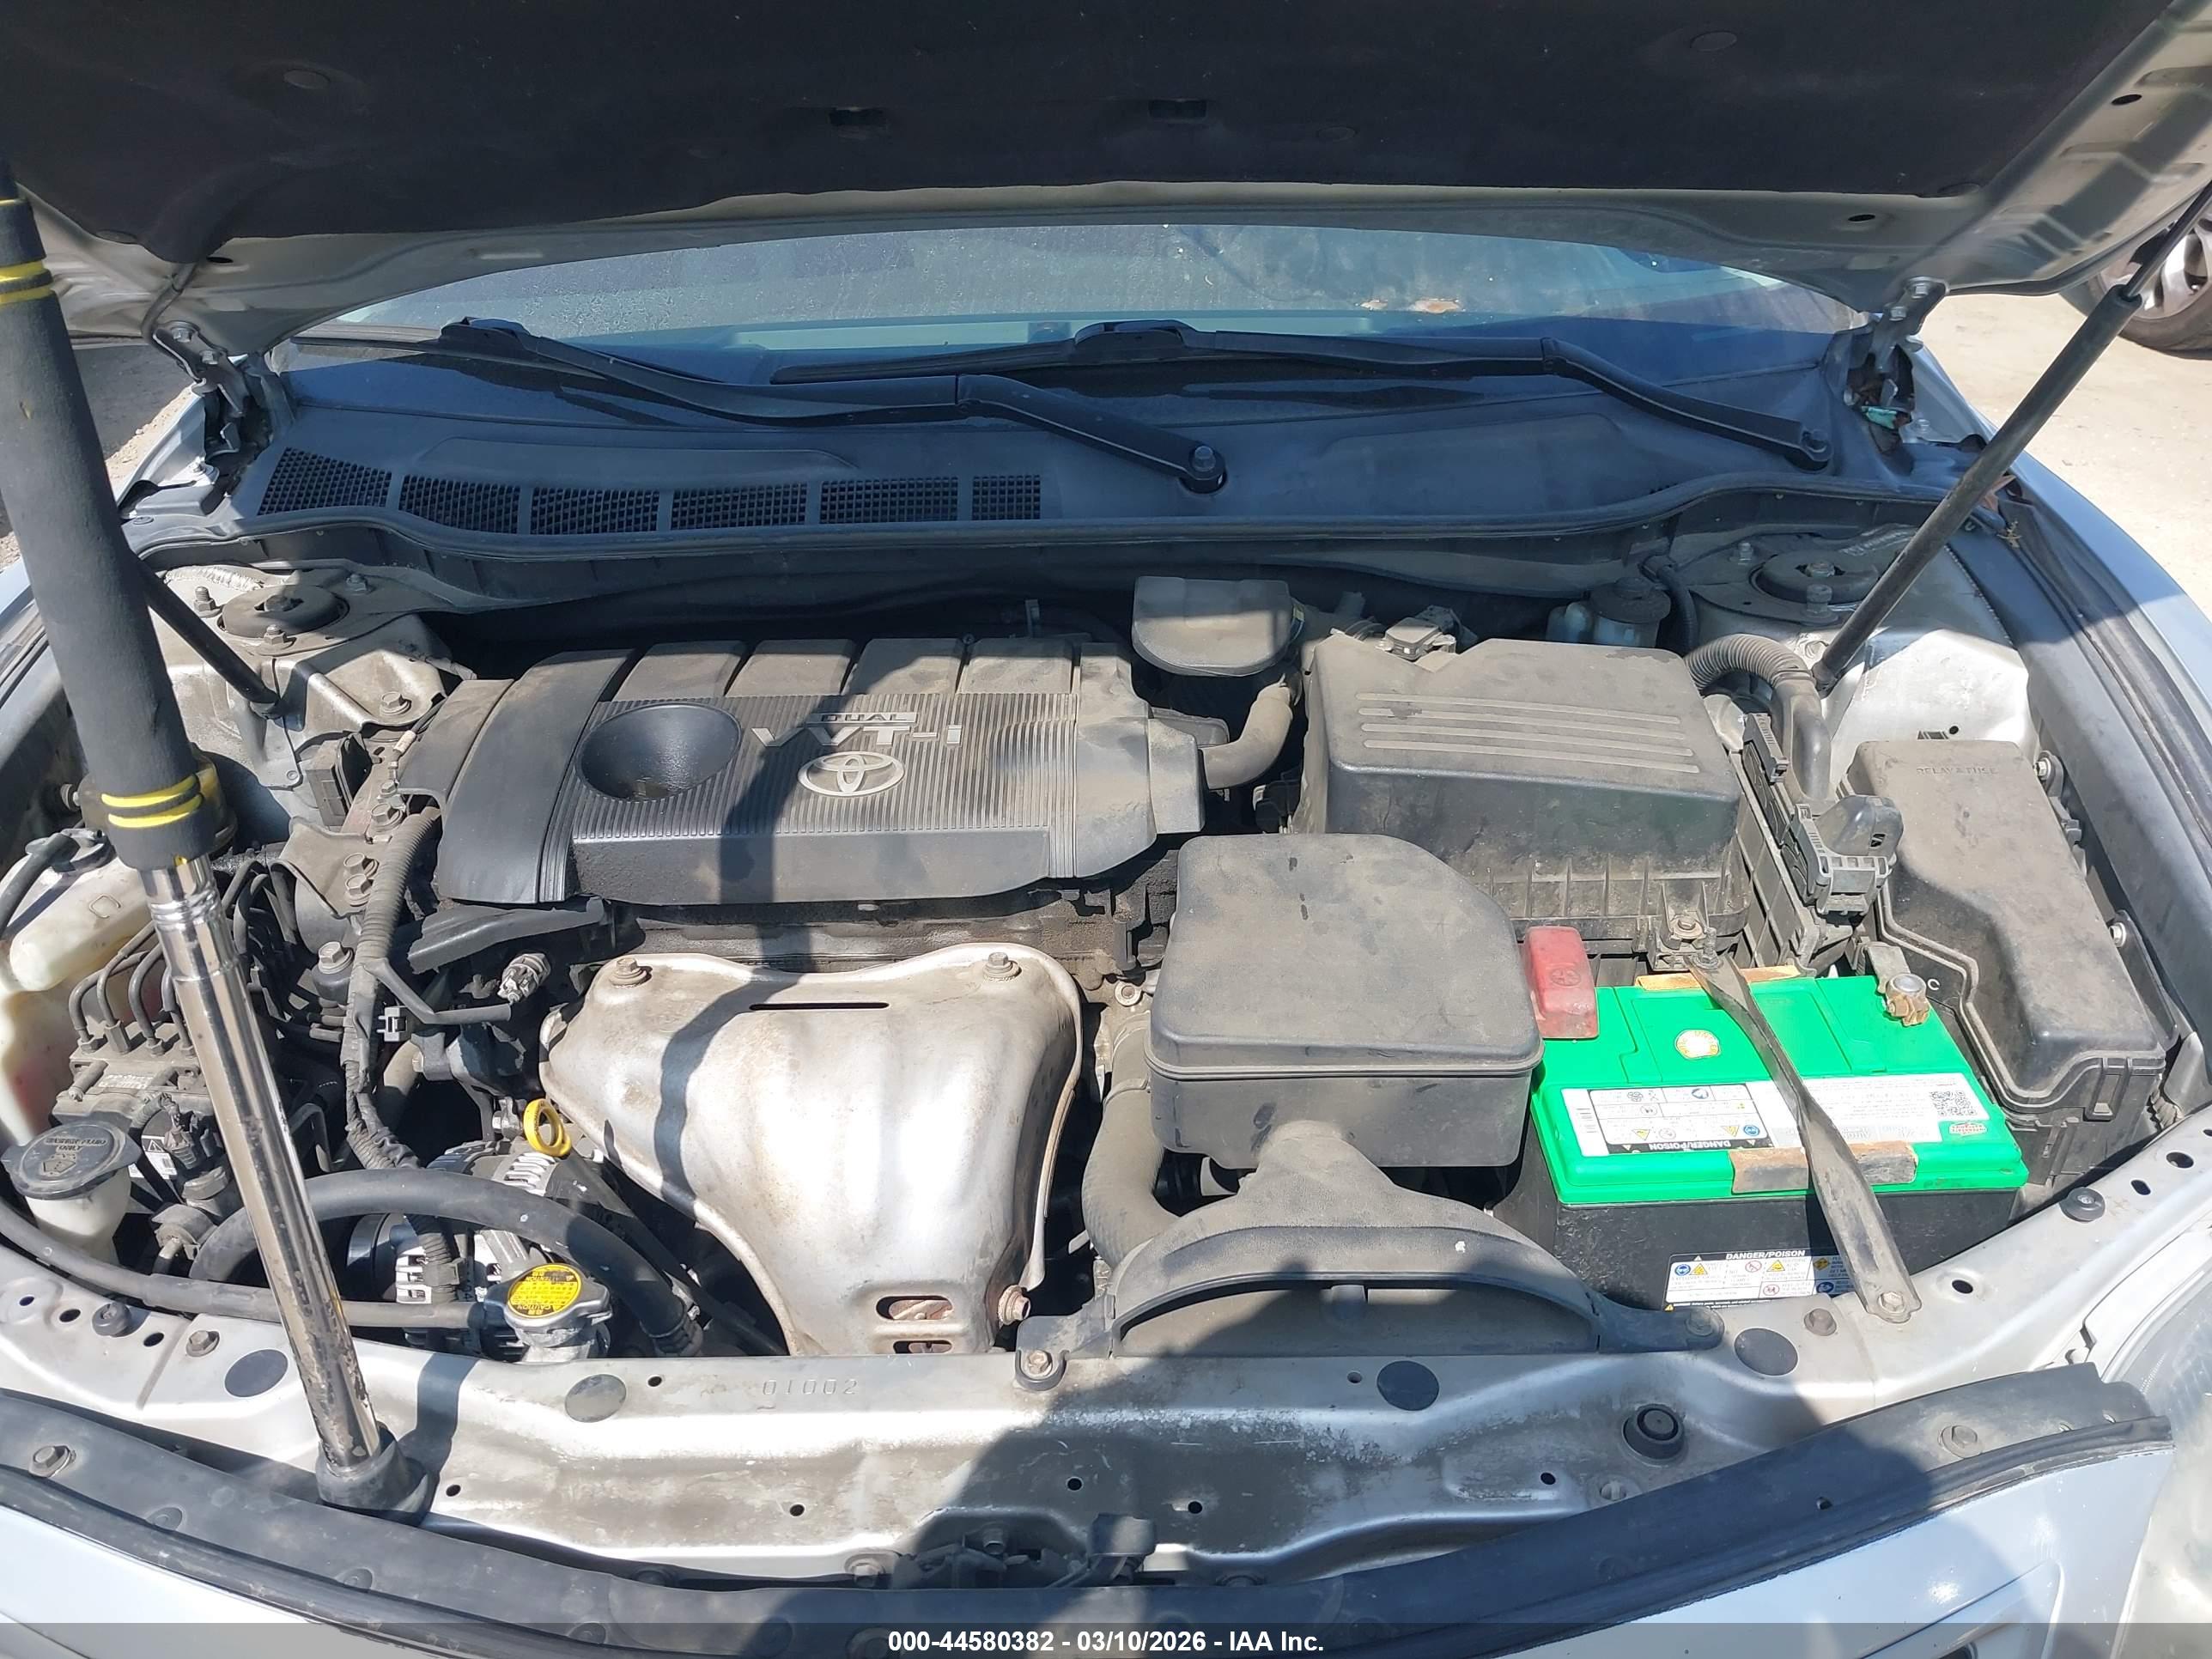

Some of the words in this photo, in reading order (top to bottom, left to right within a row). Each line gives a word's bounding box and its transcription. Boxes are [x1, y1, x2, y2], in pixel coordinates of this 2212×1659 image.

[820, 713, 910, 723] DUAL
[1648, 1139, 1732, 1151] DANGER/POISON
[1725, 1249, 1806, 1261] DANGER/POISON
